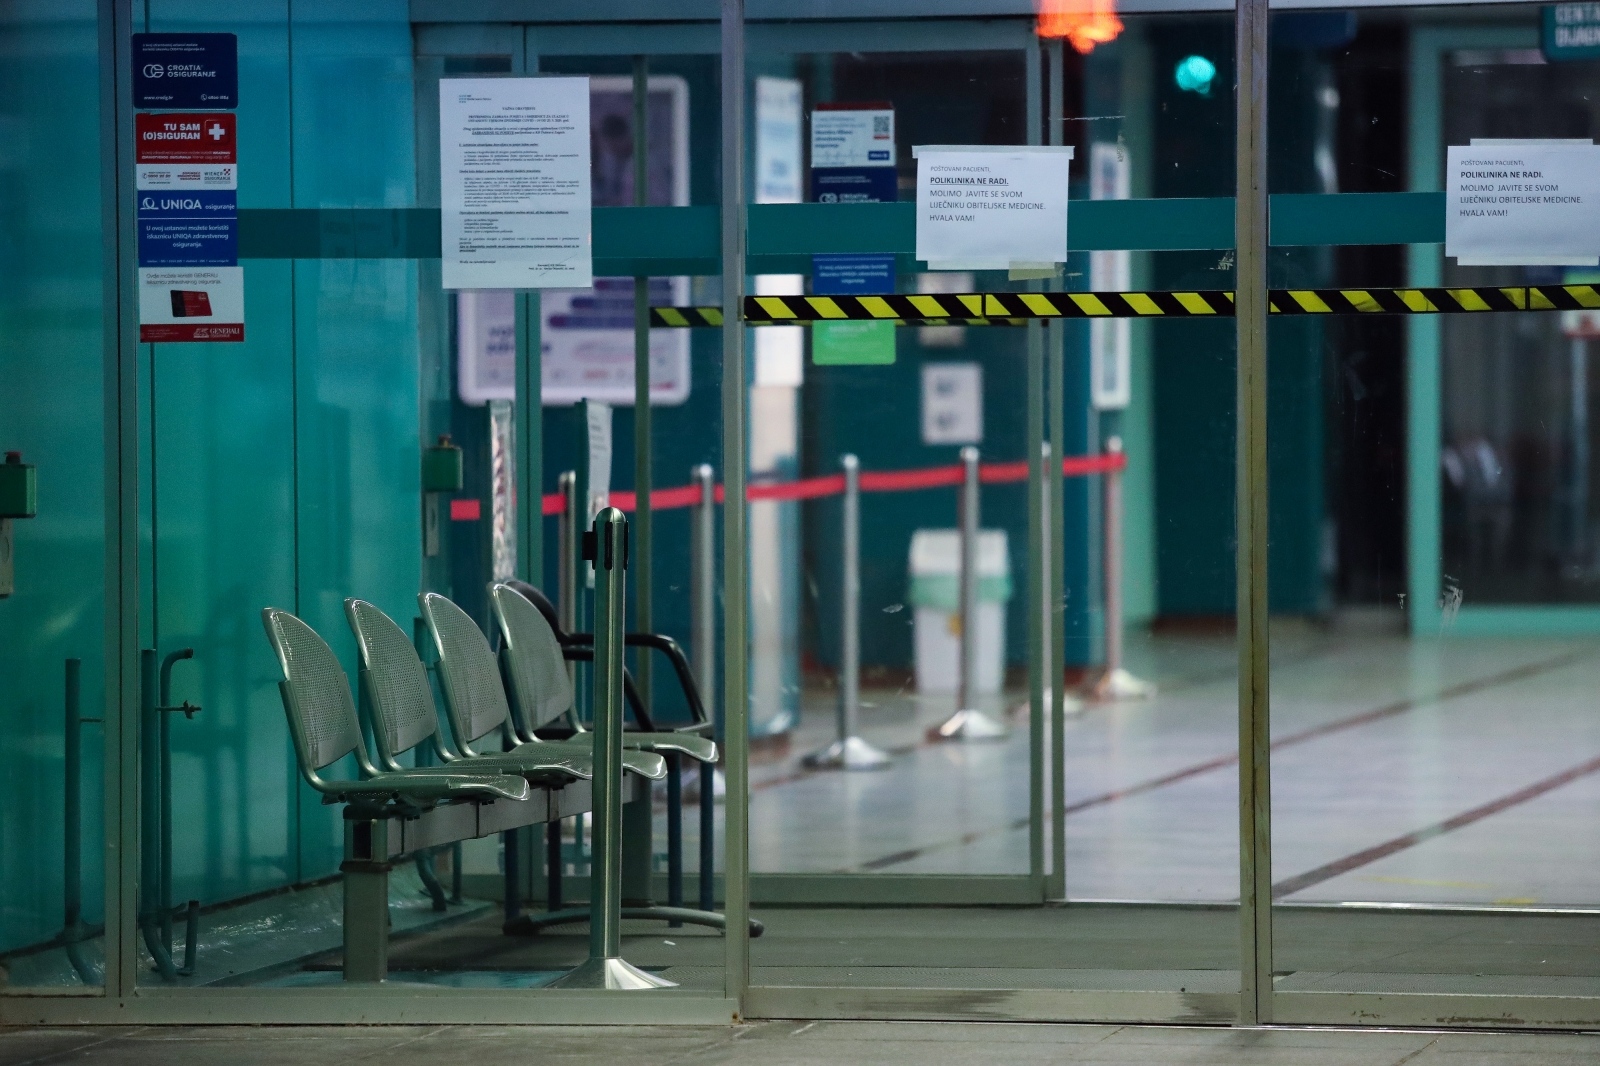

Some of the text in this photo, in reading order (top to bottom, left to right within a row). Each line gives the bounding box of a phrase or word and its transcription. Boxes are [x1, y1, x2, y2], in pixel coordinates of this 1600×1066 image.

[143, 132, 200, 140] (O)SIGURAN
[1460, 195, 1496, 203] LIJEČNIKU
[161, 200, 202, 210] UNIQA
[930, 200, 964, 209] LIJEČNIKU
